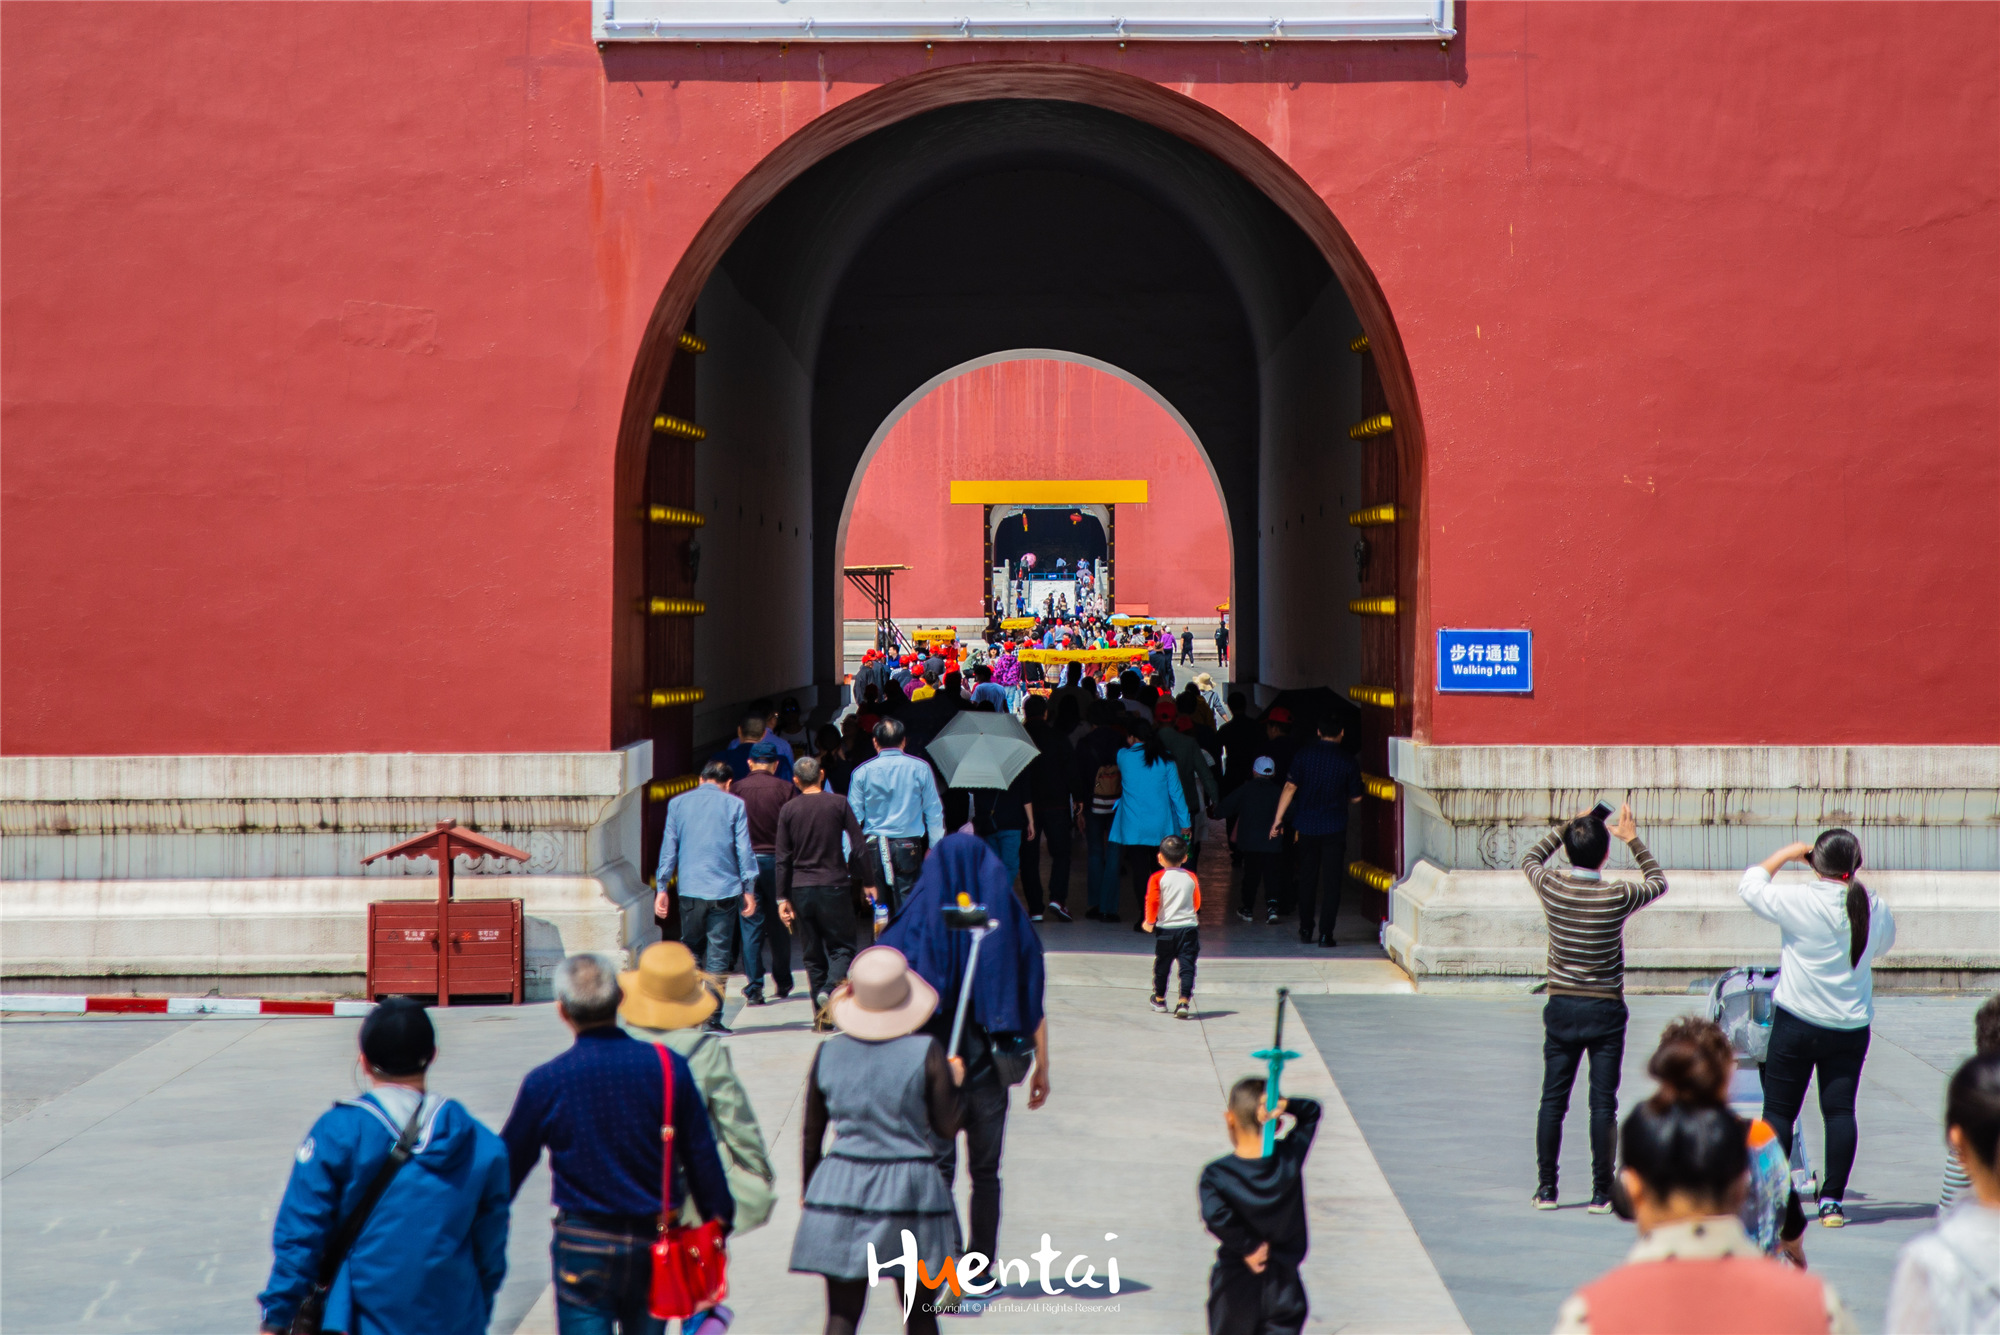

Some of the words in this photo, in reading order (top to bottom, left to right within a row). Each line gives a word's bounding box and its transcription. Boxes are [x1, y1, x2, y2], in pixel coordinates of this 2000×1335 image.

[1450, 644, 1520, 662] 步行通道
[1453, 664, 1493, 677] Walking
[1495, 664, 1517, 675] Path
